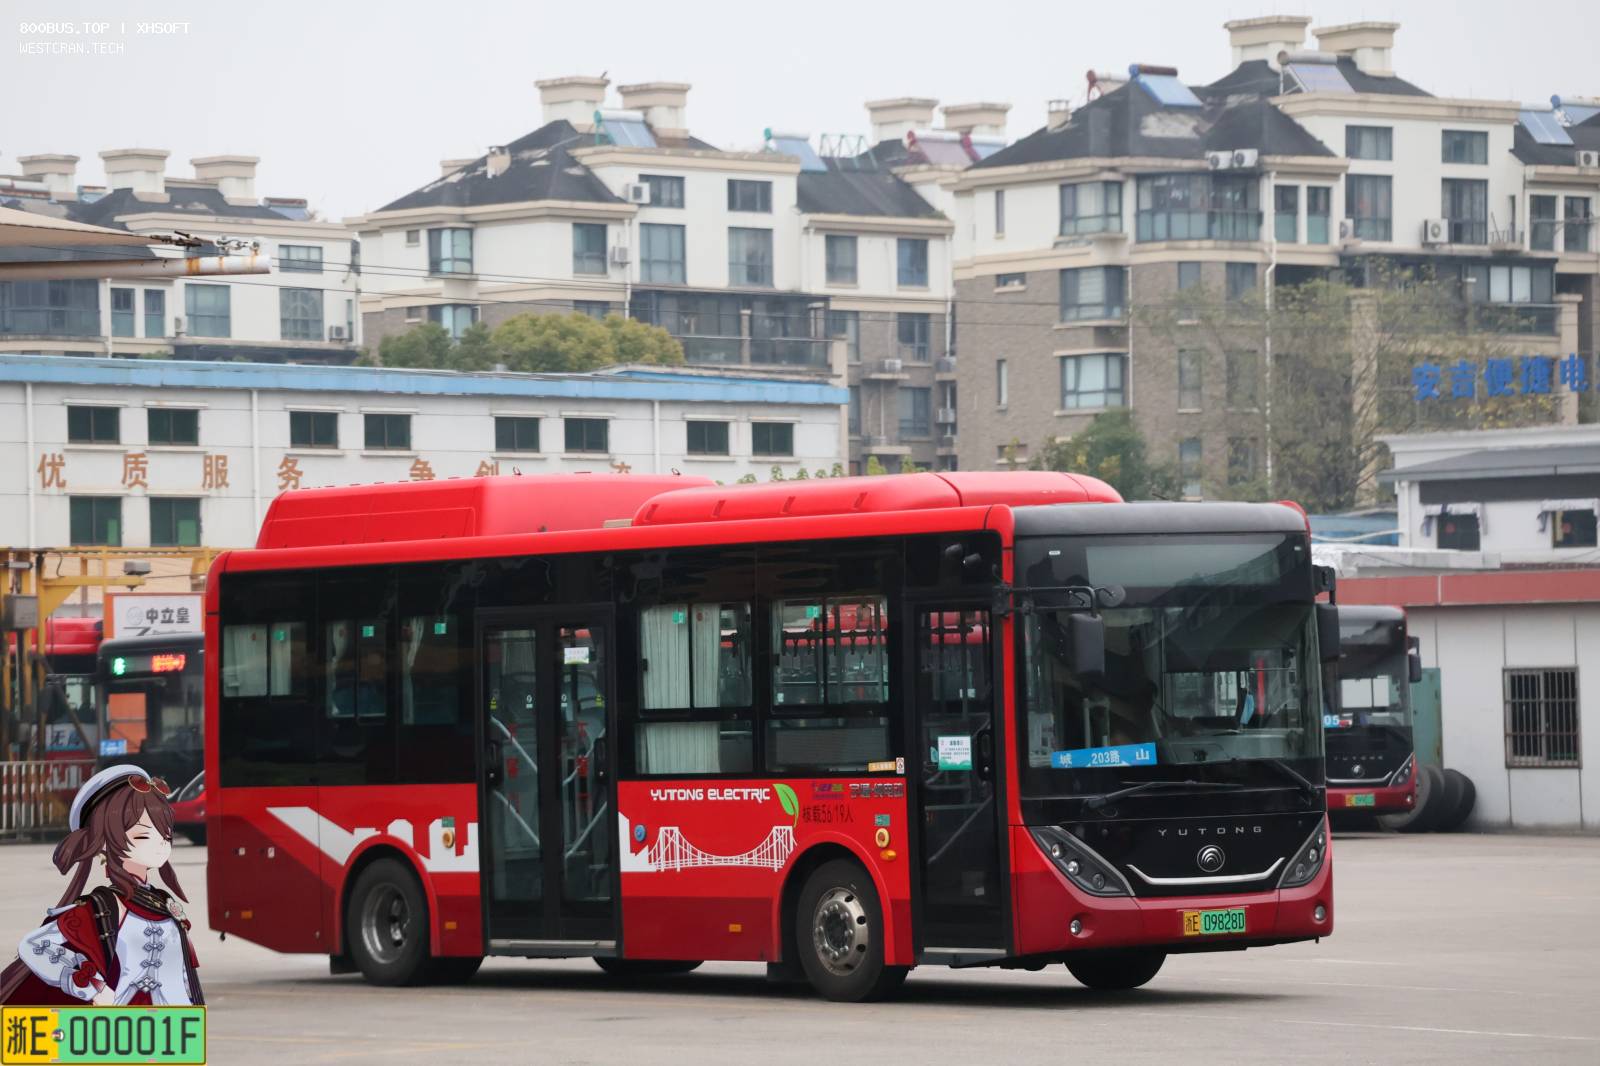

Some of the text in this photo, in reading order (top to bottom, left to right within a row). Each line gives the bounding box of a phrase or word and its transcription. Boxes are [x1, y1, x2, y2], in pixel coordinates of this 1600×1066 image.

[1411, 353, 1600, 401] 安吉便捷电
[37, 452, 304, 491] 优质服务
[146, 607, 190, 624] 中立皇
[1091, 750, 1120, 765] 203路
[650, 788, 704, 801] YUTONG
[1158, 826, 1262, 837] YUTONG
[1204, 912, 1245, 931] 09828D
